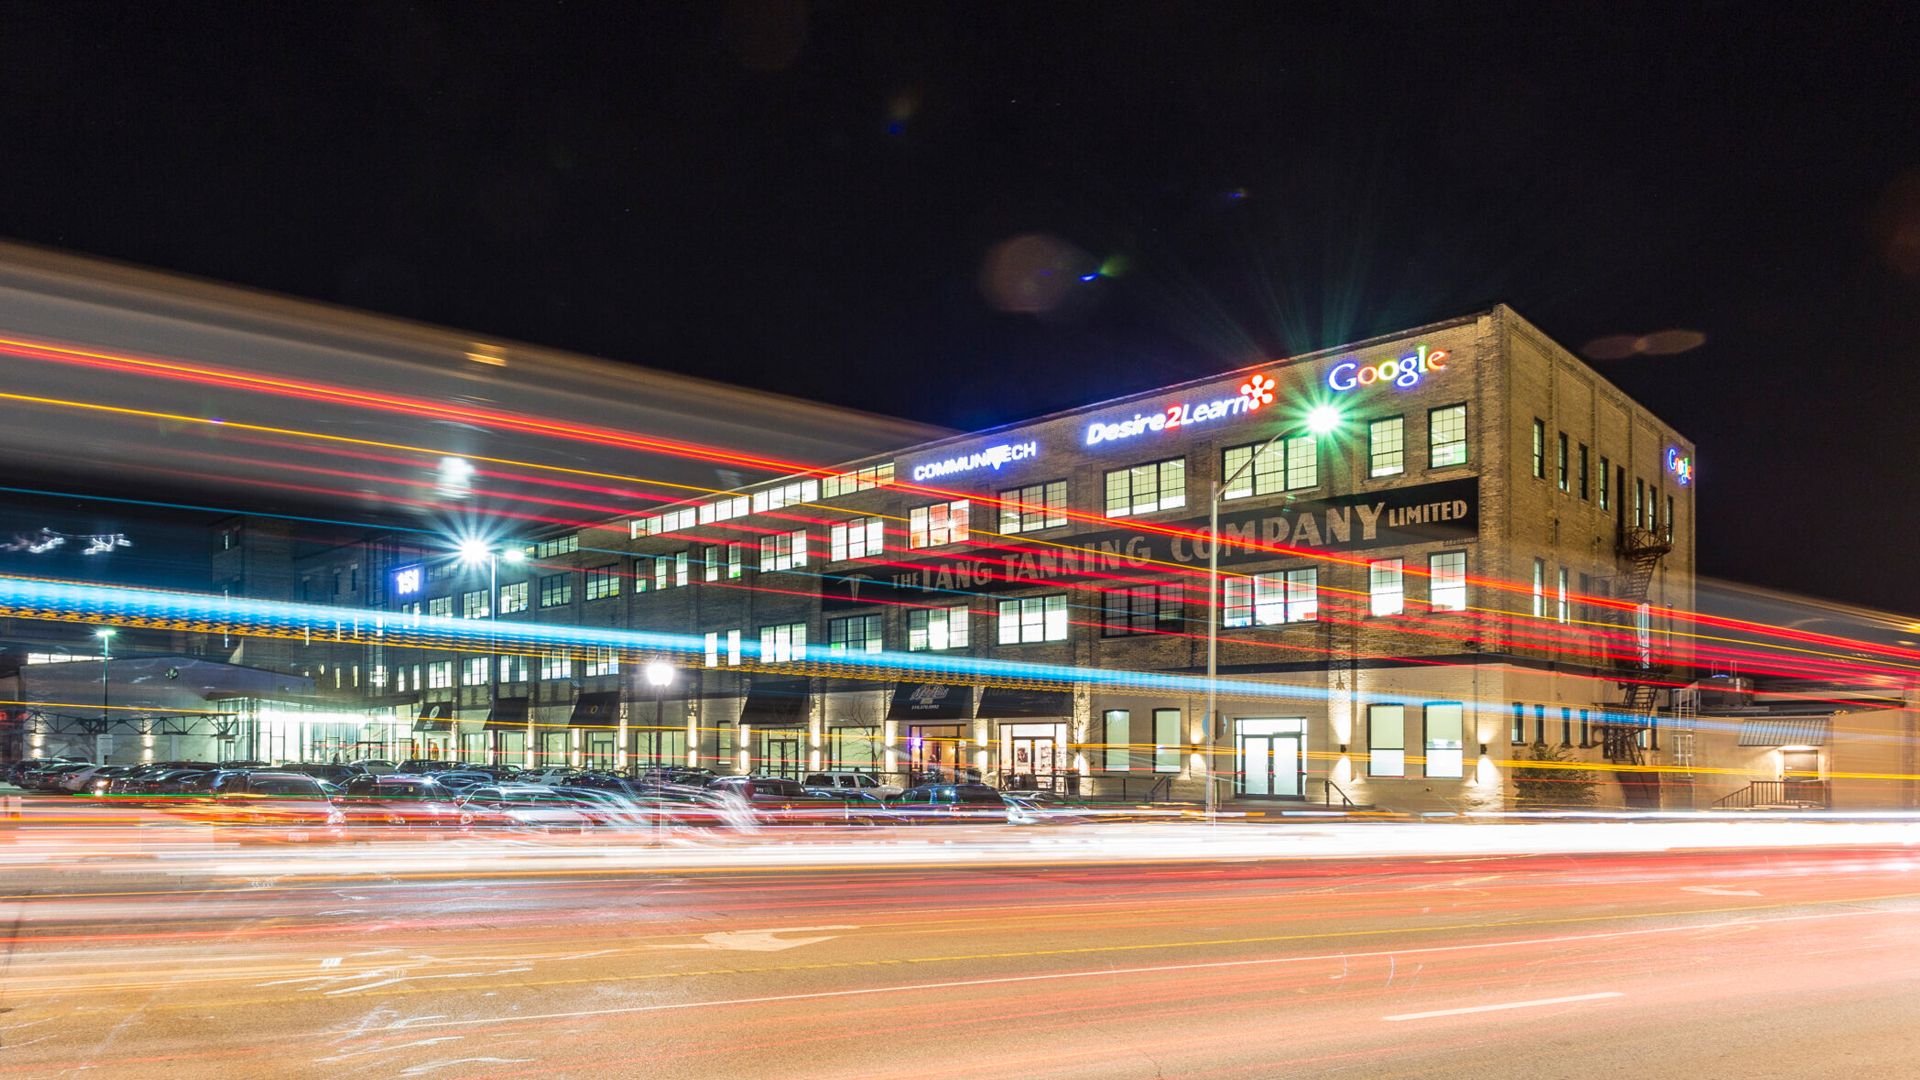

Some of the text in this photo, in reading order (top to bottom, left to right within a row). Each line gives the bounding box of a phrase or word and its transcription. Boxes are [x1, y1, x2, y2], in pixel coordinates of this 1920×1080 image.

[1328, 346, 1447, 390] Google
[1086, 396, 1250, 446] Desire2Learn
[892, 499, 1468, 593] THE LANG TANNING COMPANY LIMITED
